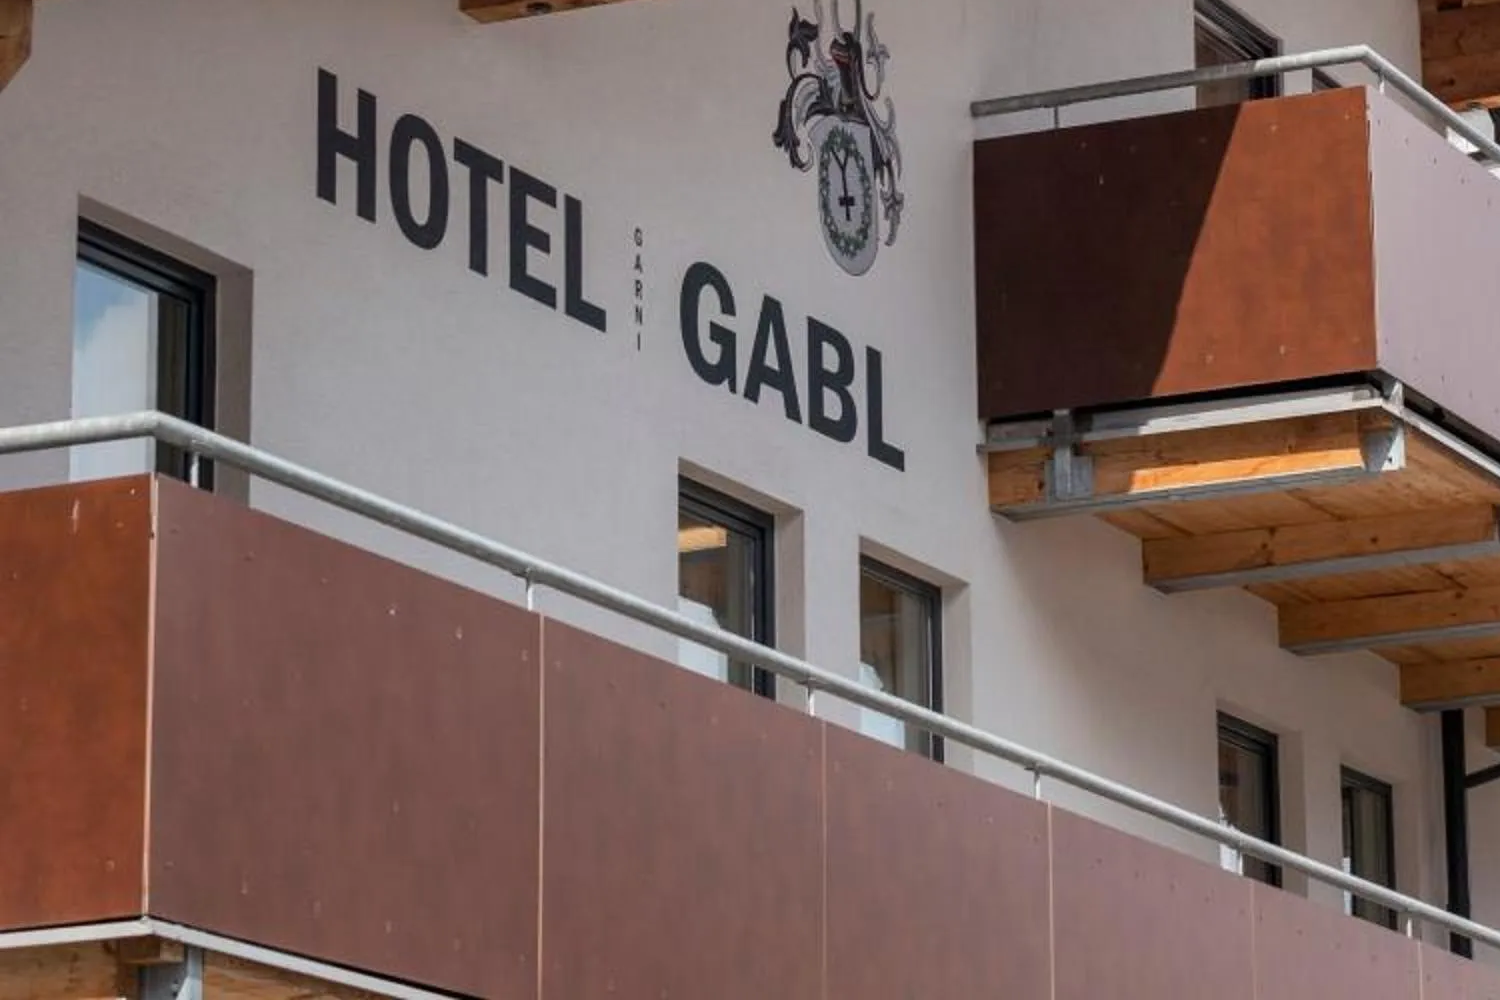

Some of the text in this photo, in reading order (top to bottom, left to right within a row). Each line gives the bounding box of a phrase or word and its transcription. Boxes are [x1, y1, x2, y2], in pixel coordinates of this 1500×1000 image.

[316, 66, 905, 473] HOTEL GABL
[633, 226, 644, 352] GARNI
